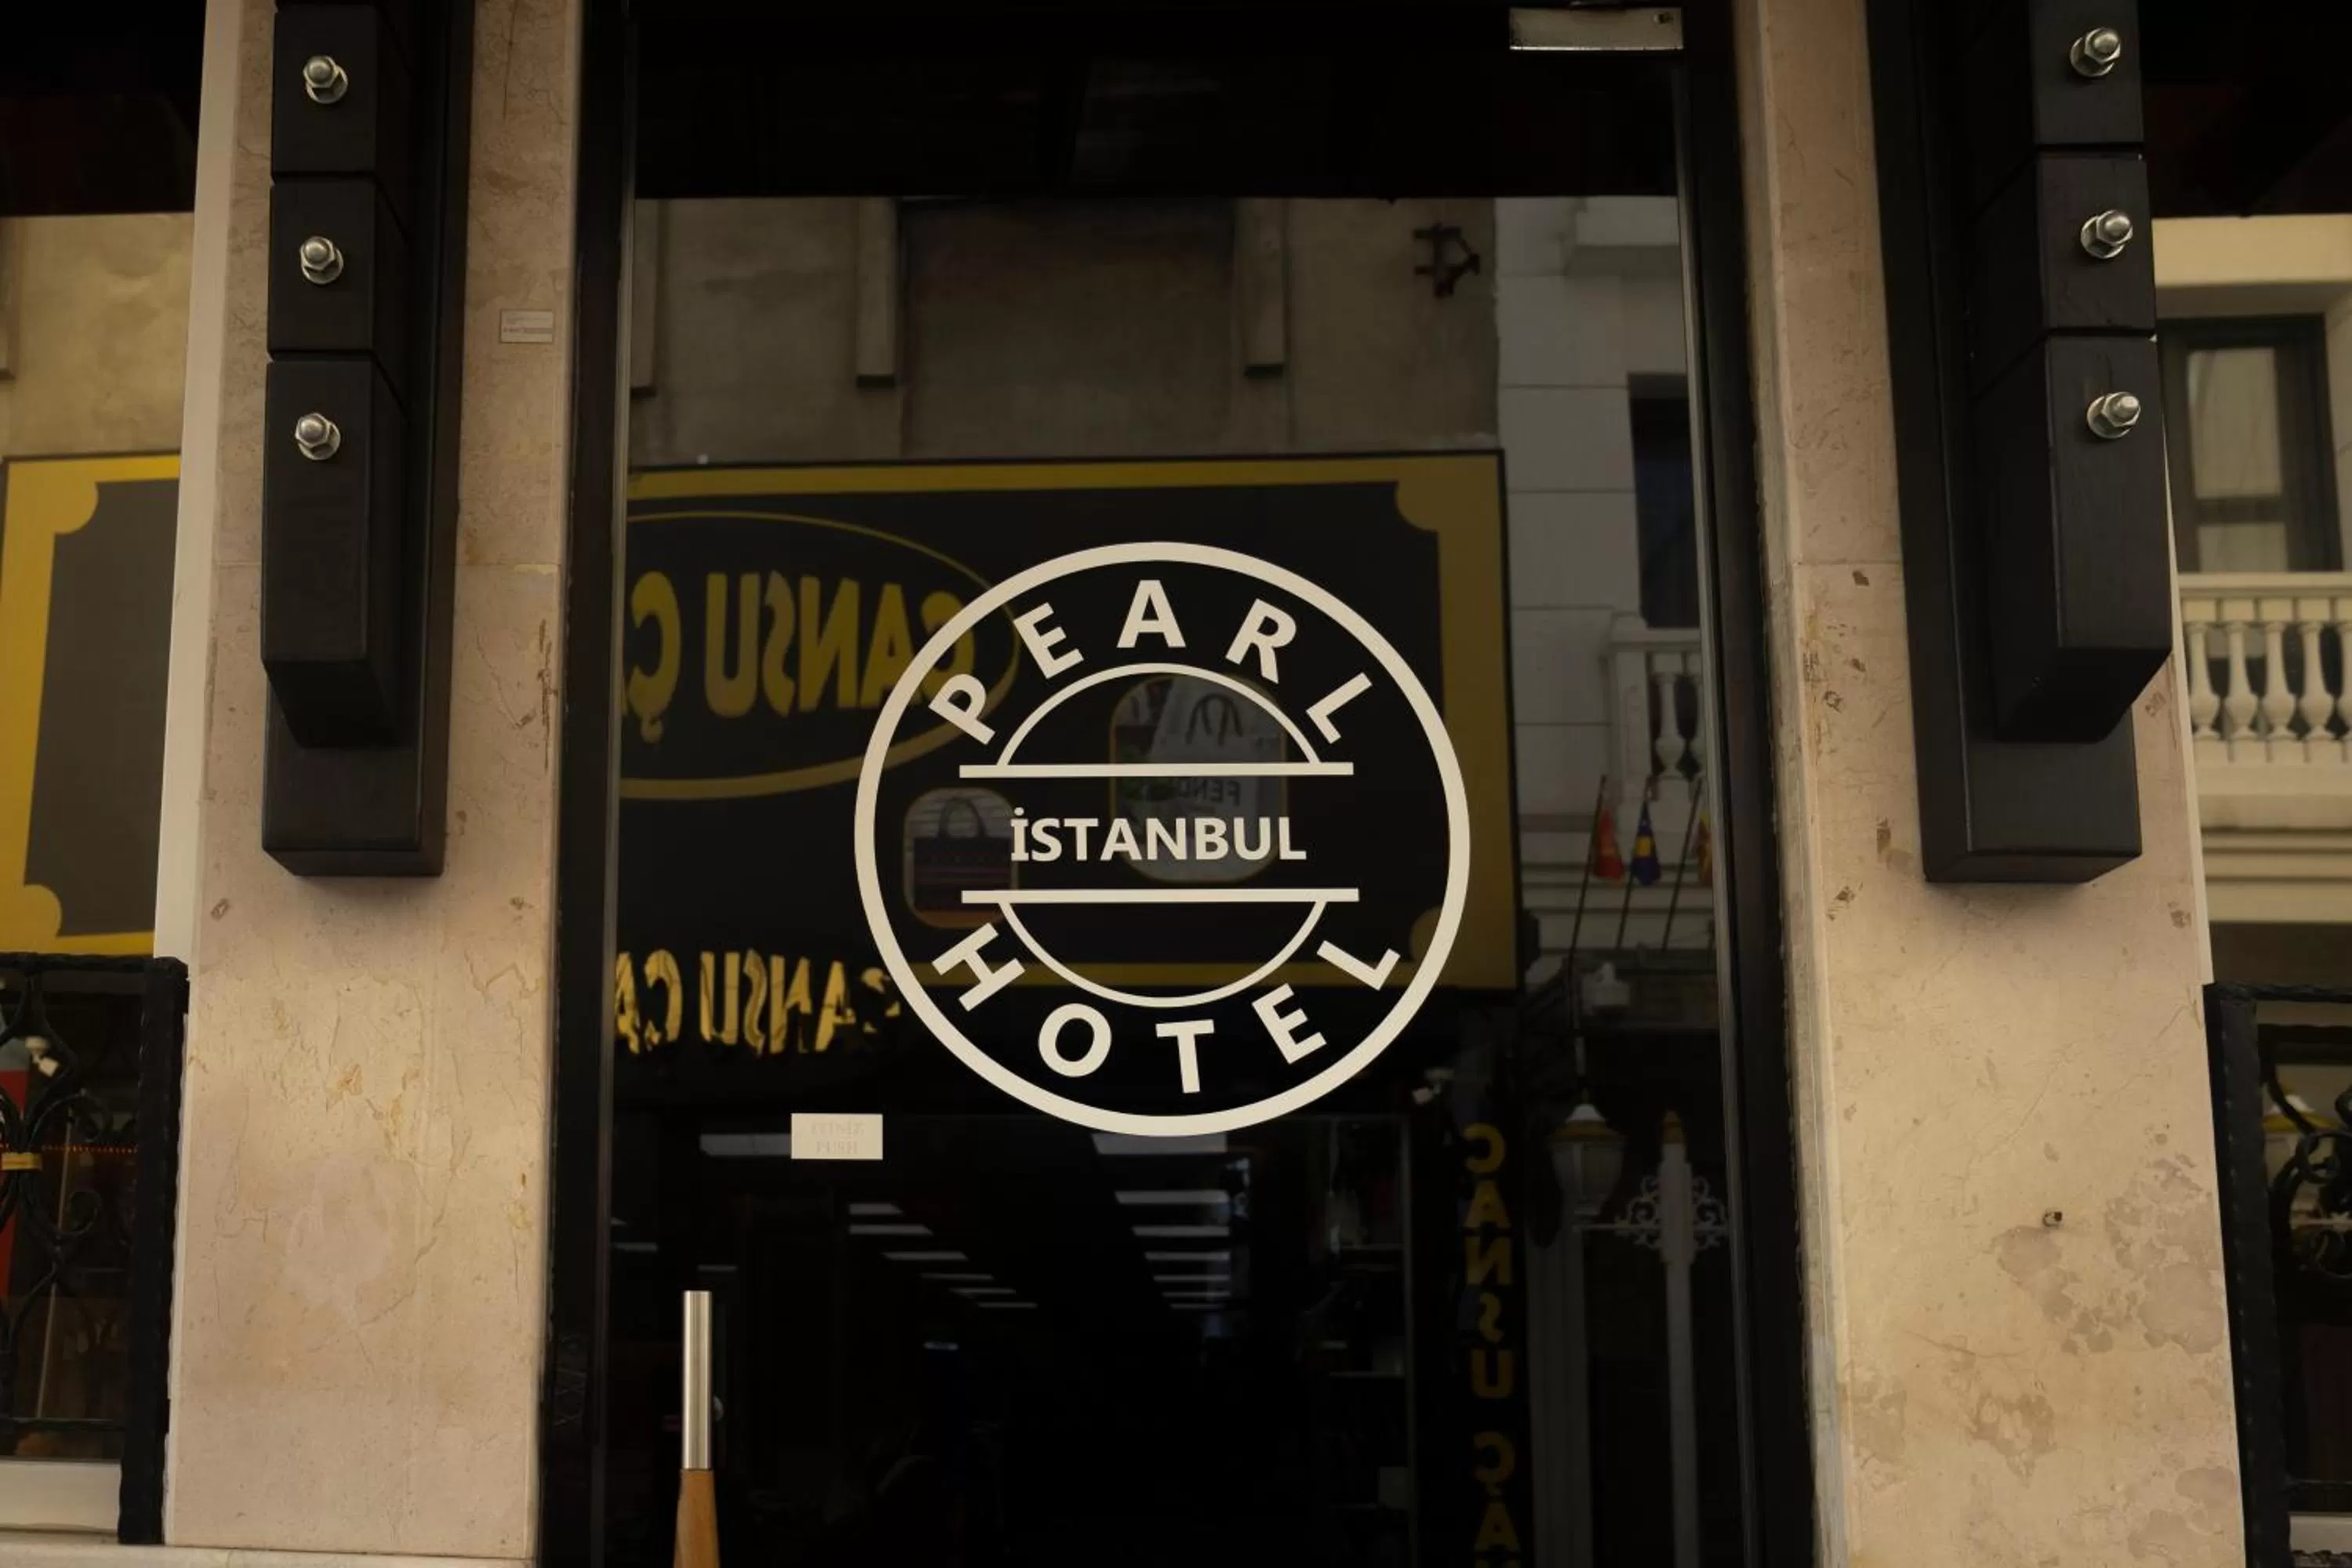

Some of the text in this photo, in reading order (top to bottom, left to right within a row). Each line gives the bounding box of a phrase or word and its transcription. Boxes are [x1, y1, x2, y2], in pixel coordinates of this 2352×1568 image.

[927, 579, 1374, 746] PEARL
[1010, 807, 1307, 862] İSTANBUL
[931, 921, 1400, 1094] HOTEL
